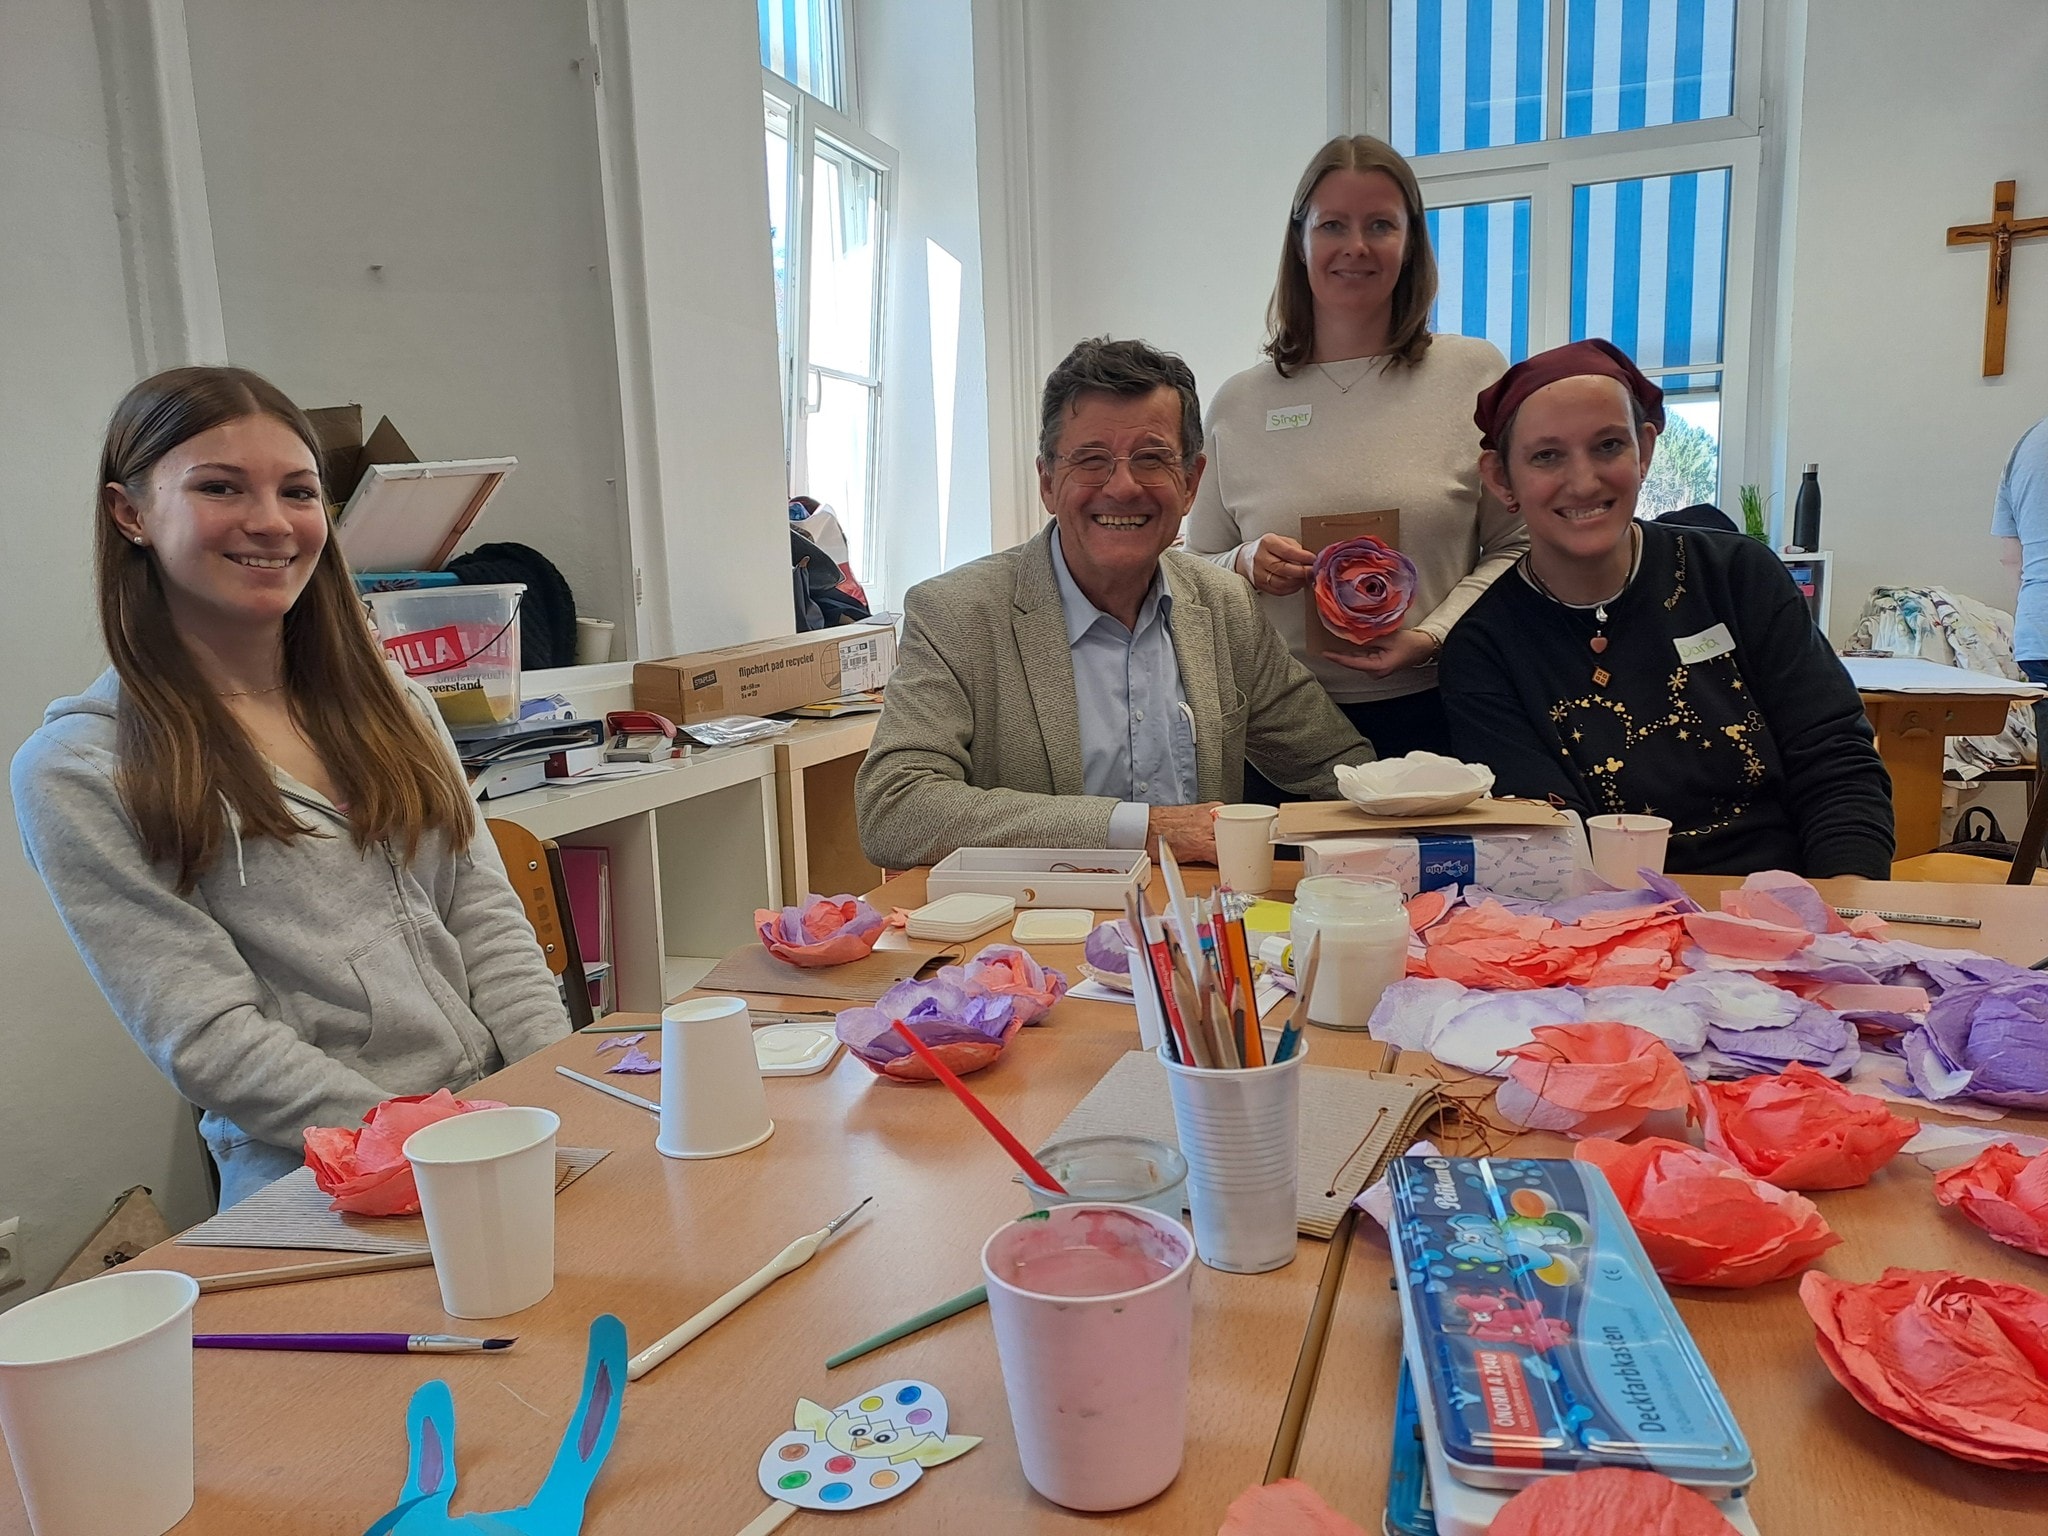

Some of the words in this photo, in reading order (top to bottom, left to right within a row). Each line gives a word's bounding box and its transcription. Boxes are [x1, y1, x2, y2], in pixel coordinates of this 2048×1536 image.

[1271, 413, 1309, 427] Singer
[1679, 637, 1720, 658] Daria
[738, 662, 770, 678] flipchart
[770, 658, 785, 672] pad
[785, 652, 814, 667] recycled
[426, 679, 484, 693] sverstand.
[694, 673, 715, 686] STAPLES
[1433, 1169, 1461, 1210] Pelikan
[1480, 1352, 1502, 1376] 2140
[1487, 1376, 1504, 1386] A
[1602, 1325, 1667, 1433] Deckfarbkasten
[1489, 1385, 1516, 1427] ÖNORM
